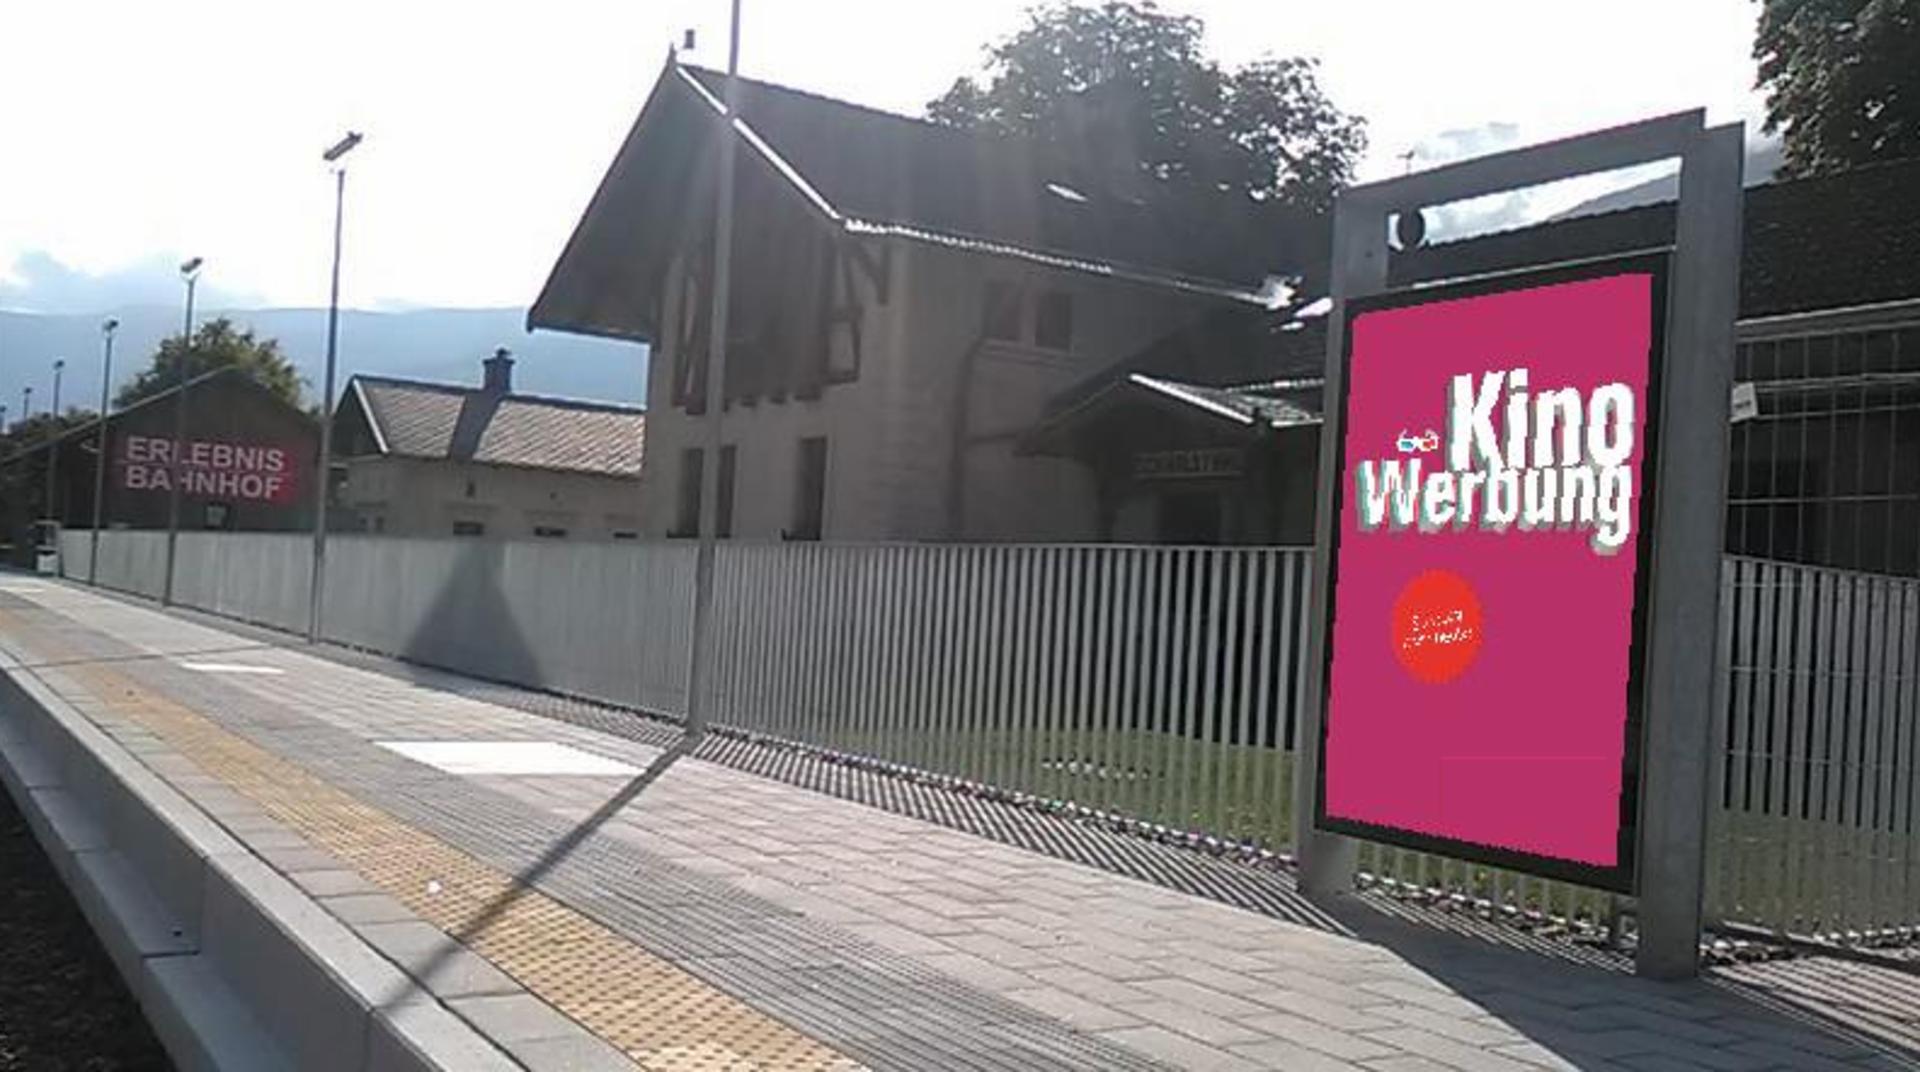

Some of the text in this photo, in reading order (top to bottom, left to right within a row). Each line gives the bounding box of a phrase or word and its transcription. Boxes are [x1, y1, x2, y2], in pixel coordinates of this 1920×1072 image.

[1448, 368, 1636, 470] Kino
[126, 465, 283, 498] BAHNHOF
[127, 436, 284, 472] ERLEBNIS
[1356, 459, 1634, 555] Werbung
